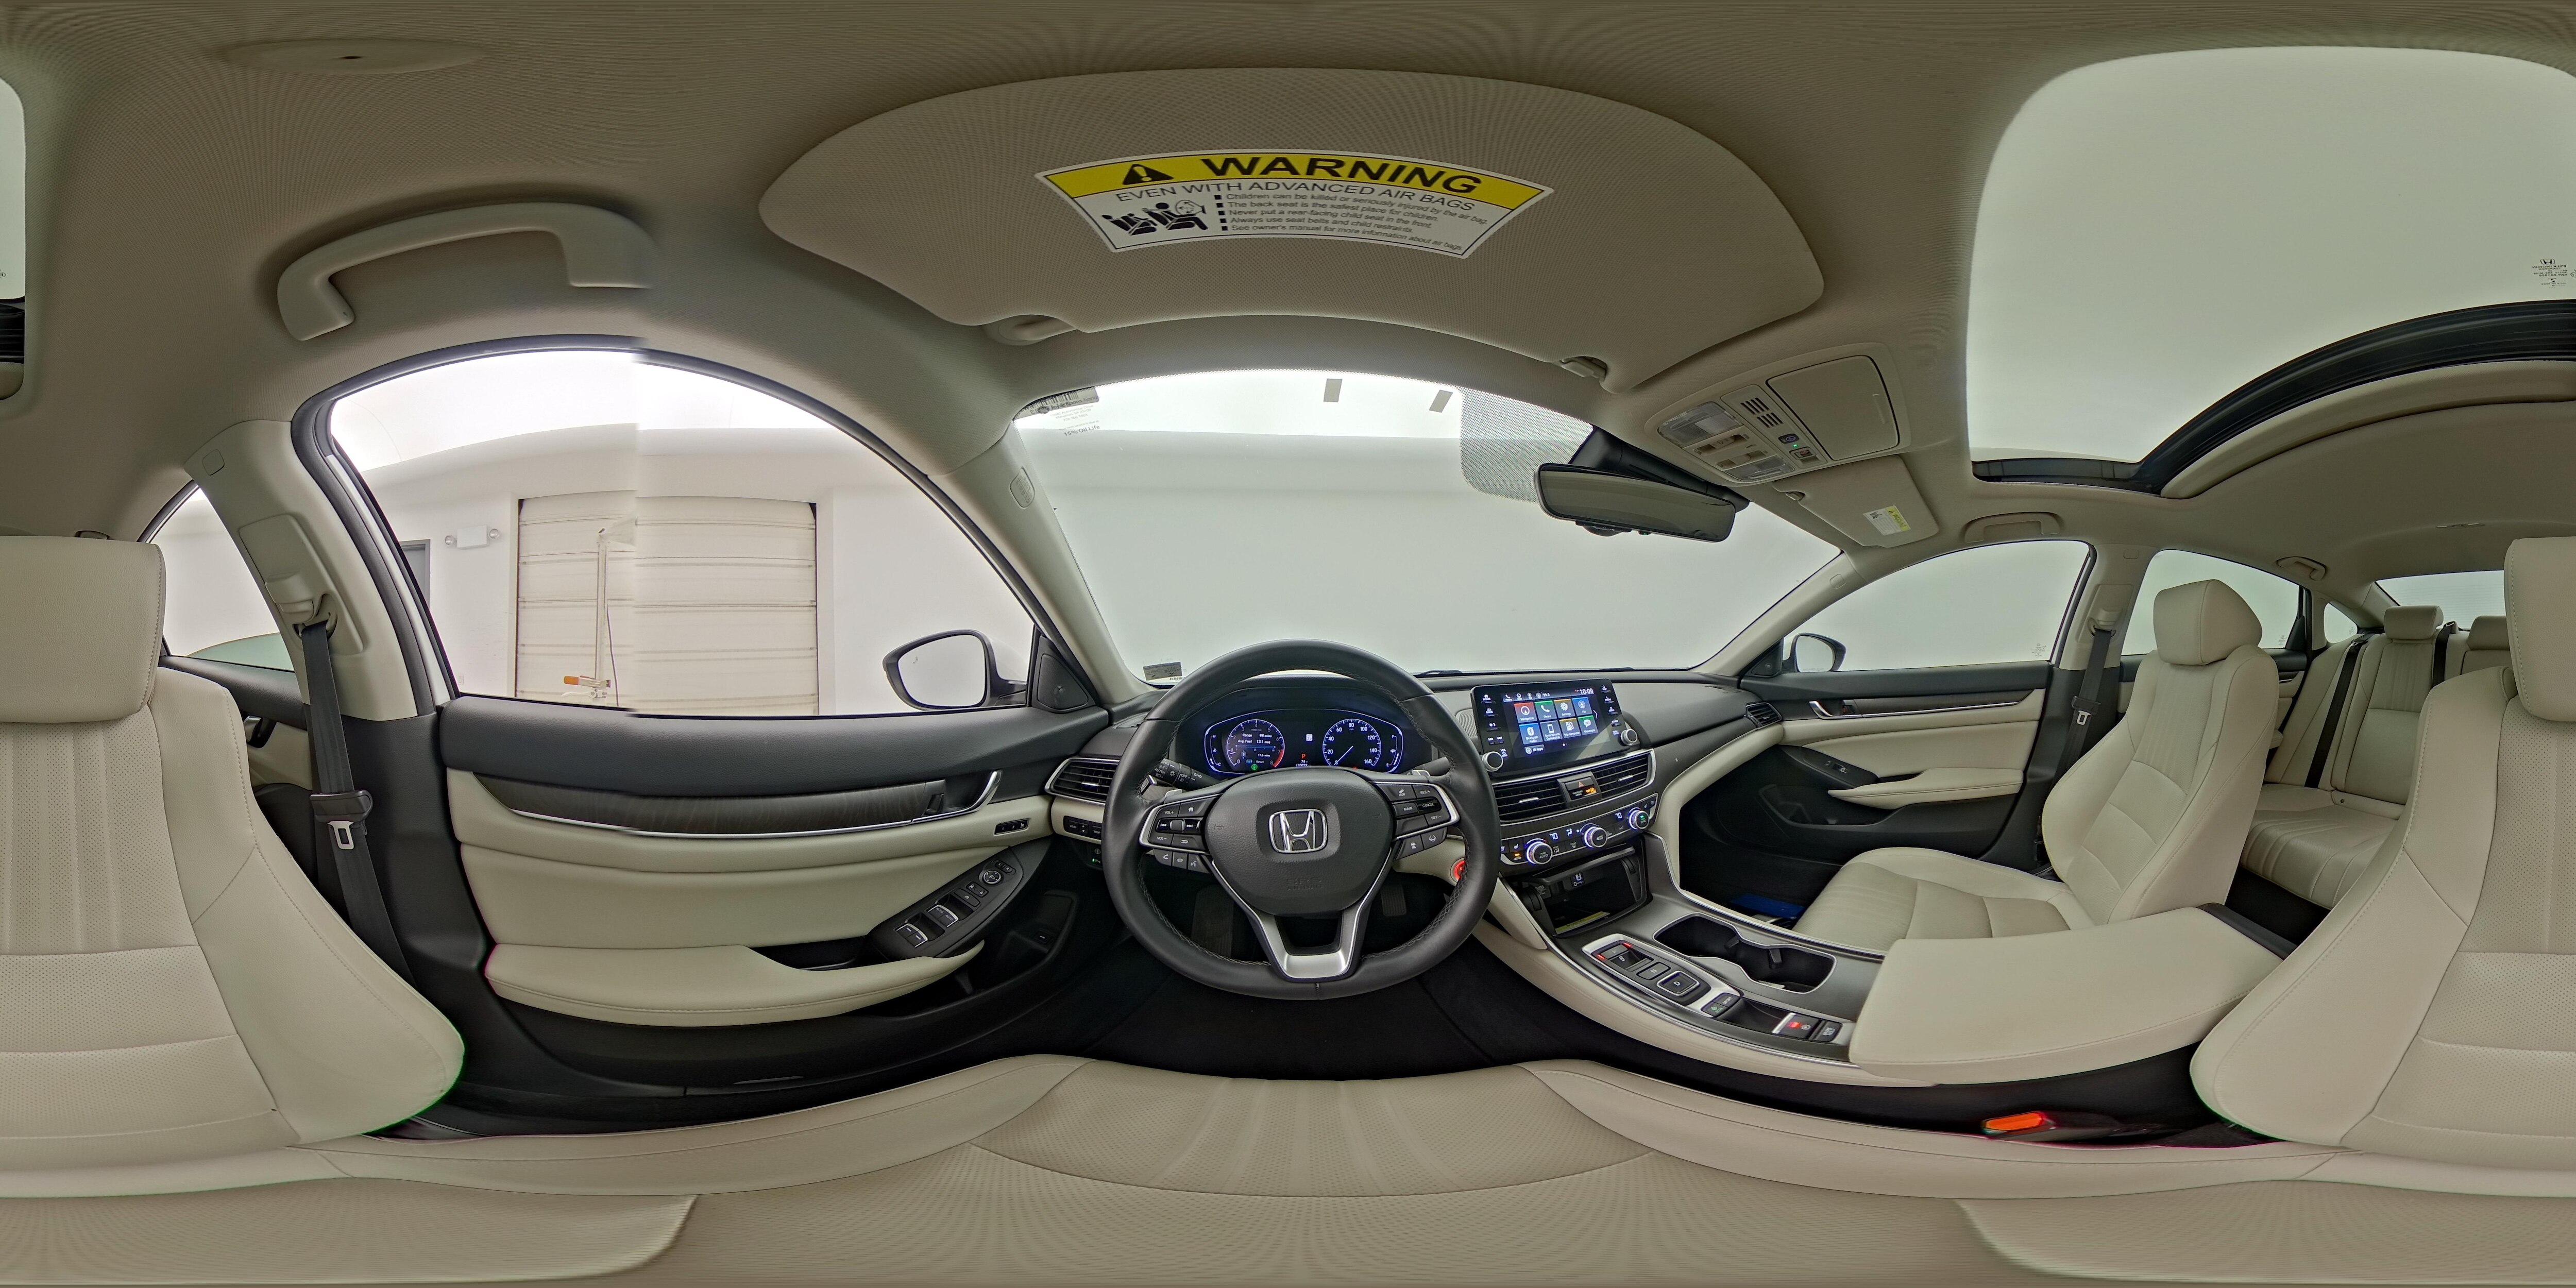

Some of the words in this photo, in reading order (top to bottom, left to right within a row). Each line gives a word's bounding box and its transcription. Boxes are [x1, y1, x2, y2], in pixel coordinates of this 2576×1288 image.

[1200, 157, 1482, 193] WARNING
[1116, 186, 1177, 201] EVEN
[1181, 182, 1242, 194] WITH
[1248, 181, 1375, 195] ADVANCED
[1377, 189, 1416, 201] AIR
[1419, 194, 1475, 211] BAGS
[1287, 210, 1338, 218] rear-facing
[1412, 220, 1432, 228] front.
[1352, 198, 1395, 207] seriously
[1398, 202, 1428, 211] injured
[1470, 215, 1487, 225] bag.
[1402, 211, 1438, 222] children.
[1374, 223, 1413, 233] restraints.
[1362, 230, 1408, 240] information
[1409, 235, 1431, 244] about
[1443, 241, 1462, 251] bags.
